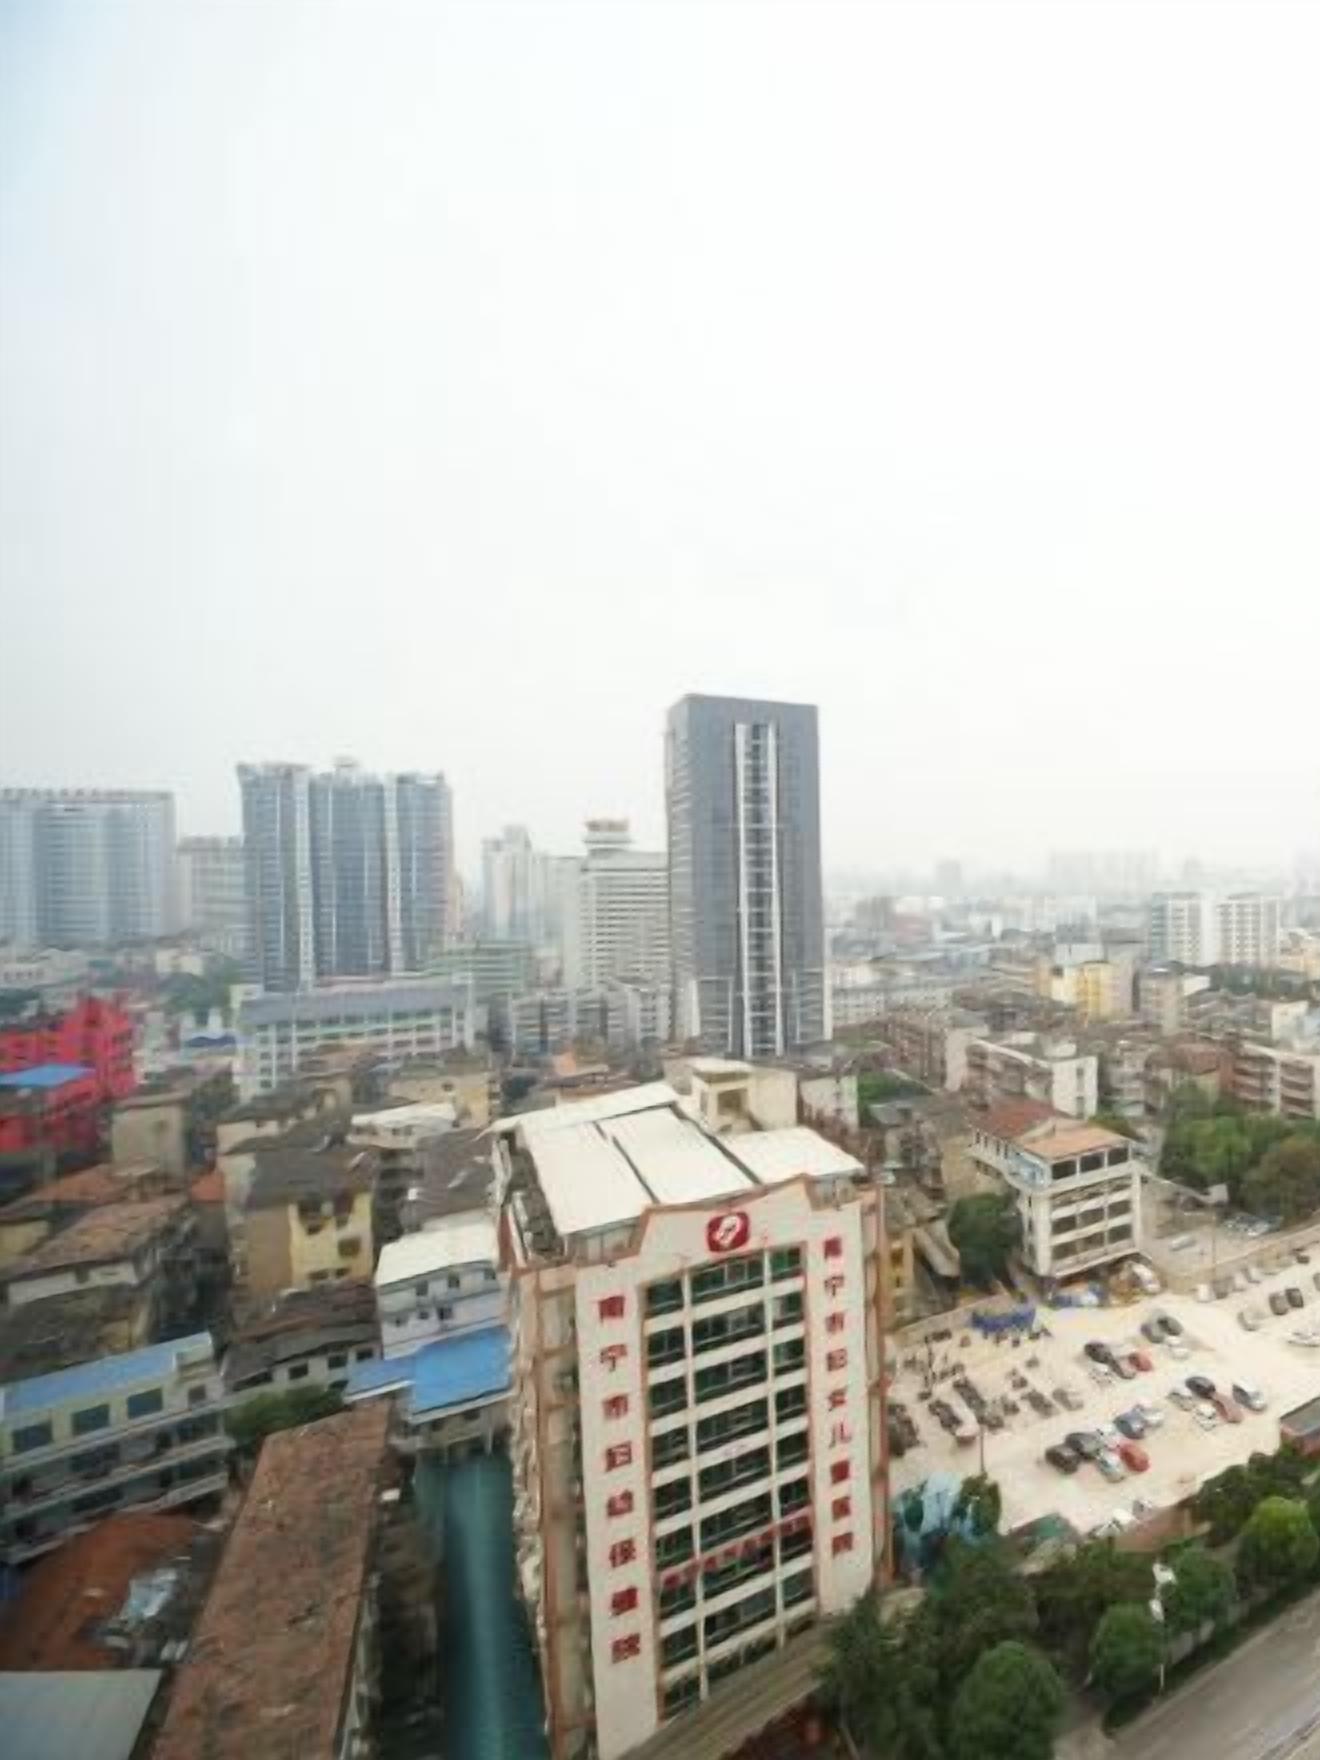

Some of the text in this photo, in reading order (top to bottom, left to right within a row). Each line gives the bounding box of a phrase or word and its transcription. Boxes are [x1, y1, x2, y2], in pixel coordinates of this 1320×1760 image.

[824, 1237, 853, 1557] 宁市妇女儿
